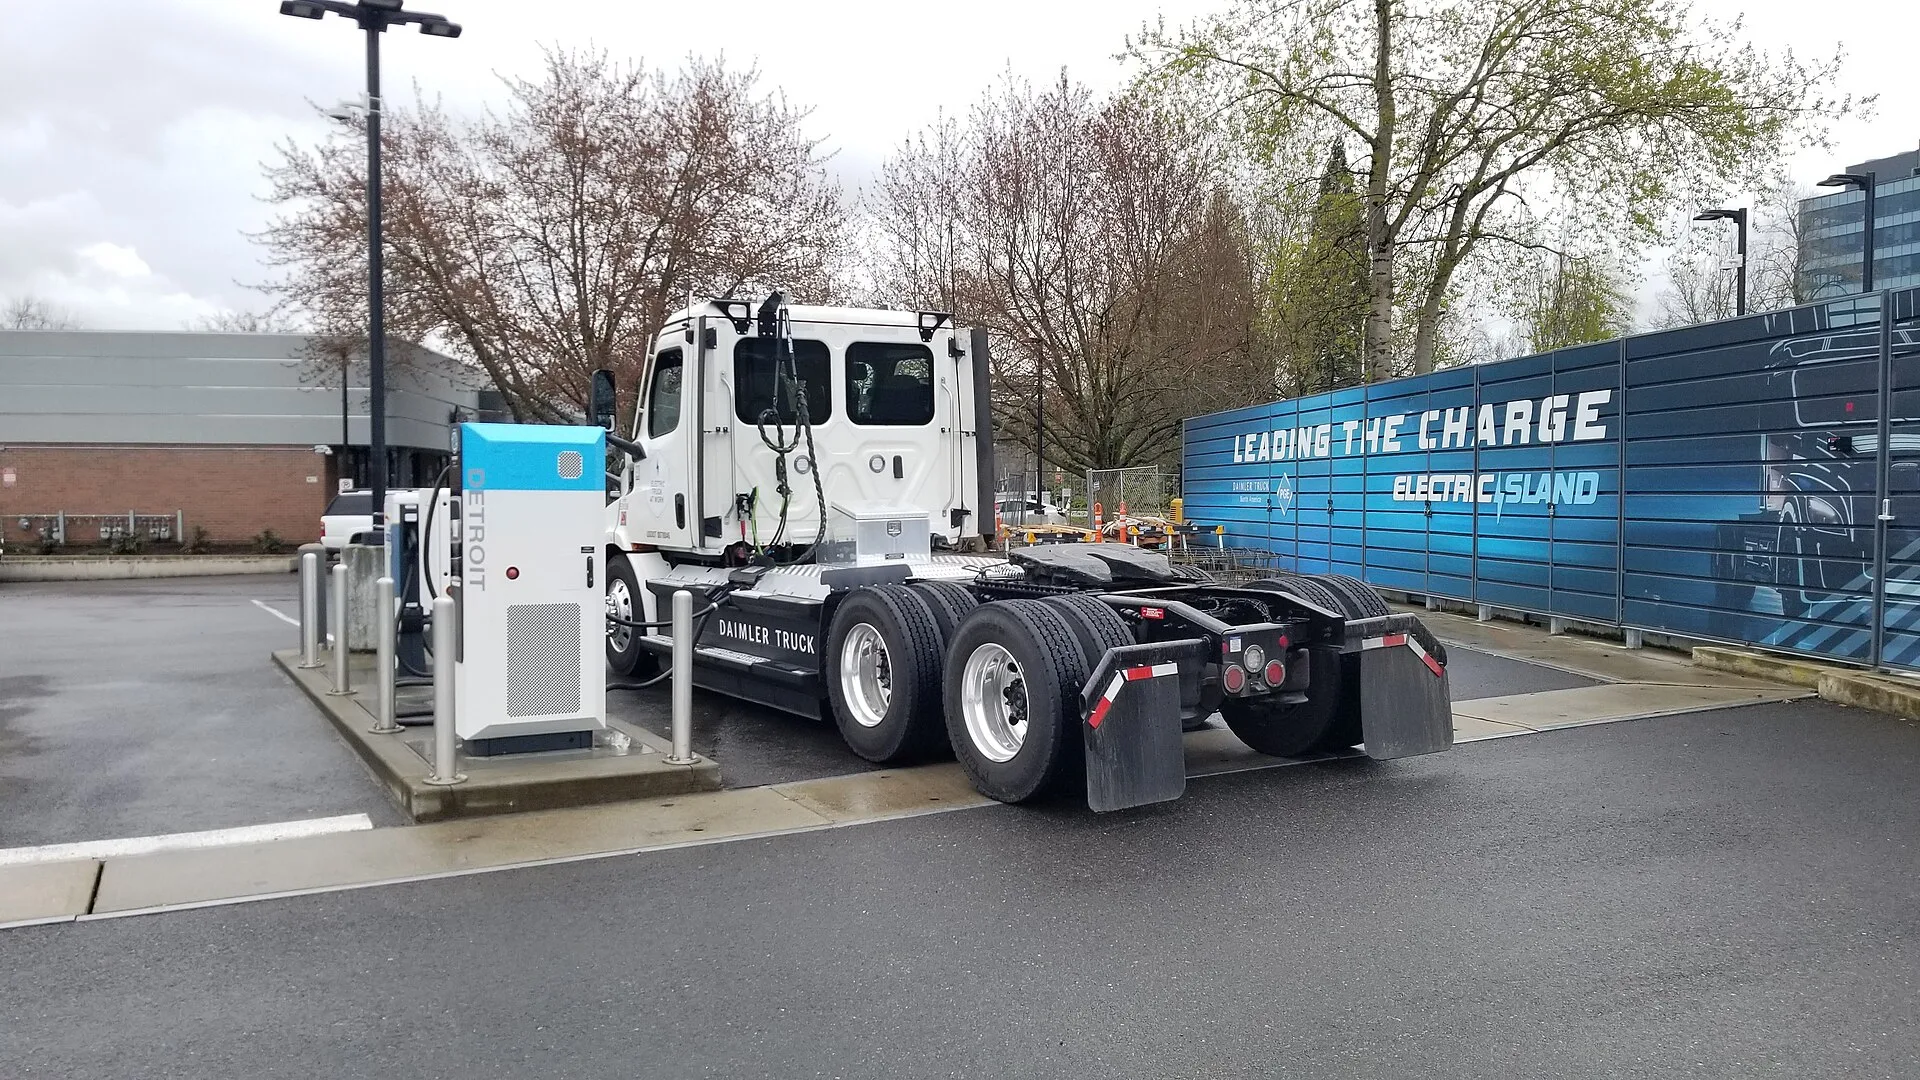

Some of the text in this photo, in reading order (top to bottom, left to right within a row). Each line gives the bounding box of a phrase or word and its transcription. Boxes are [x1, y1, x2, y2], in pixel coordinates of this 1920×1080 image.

[1233, 389, 1612, 463] LEADING THE CHARGE
[1232, 482, 1270, 491] DAIMLER TRUCK
[1280, 488, 1290, 500] PGE
[468, 468, 486, 591] DETROIT
[719, 619, 815, 655] DAIMLER TRUCK
